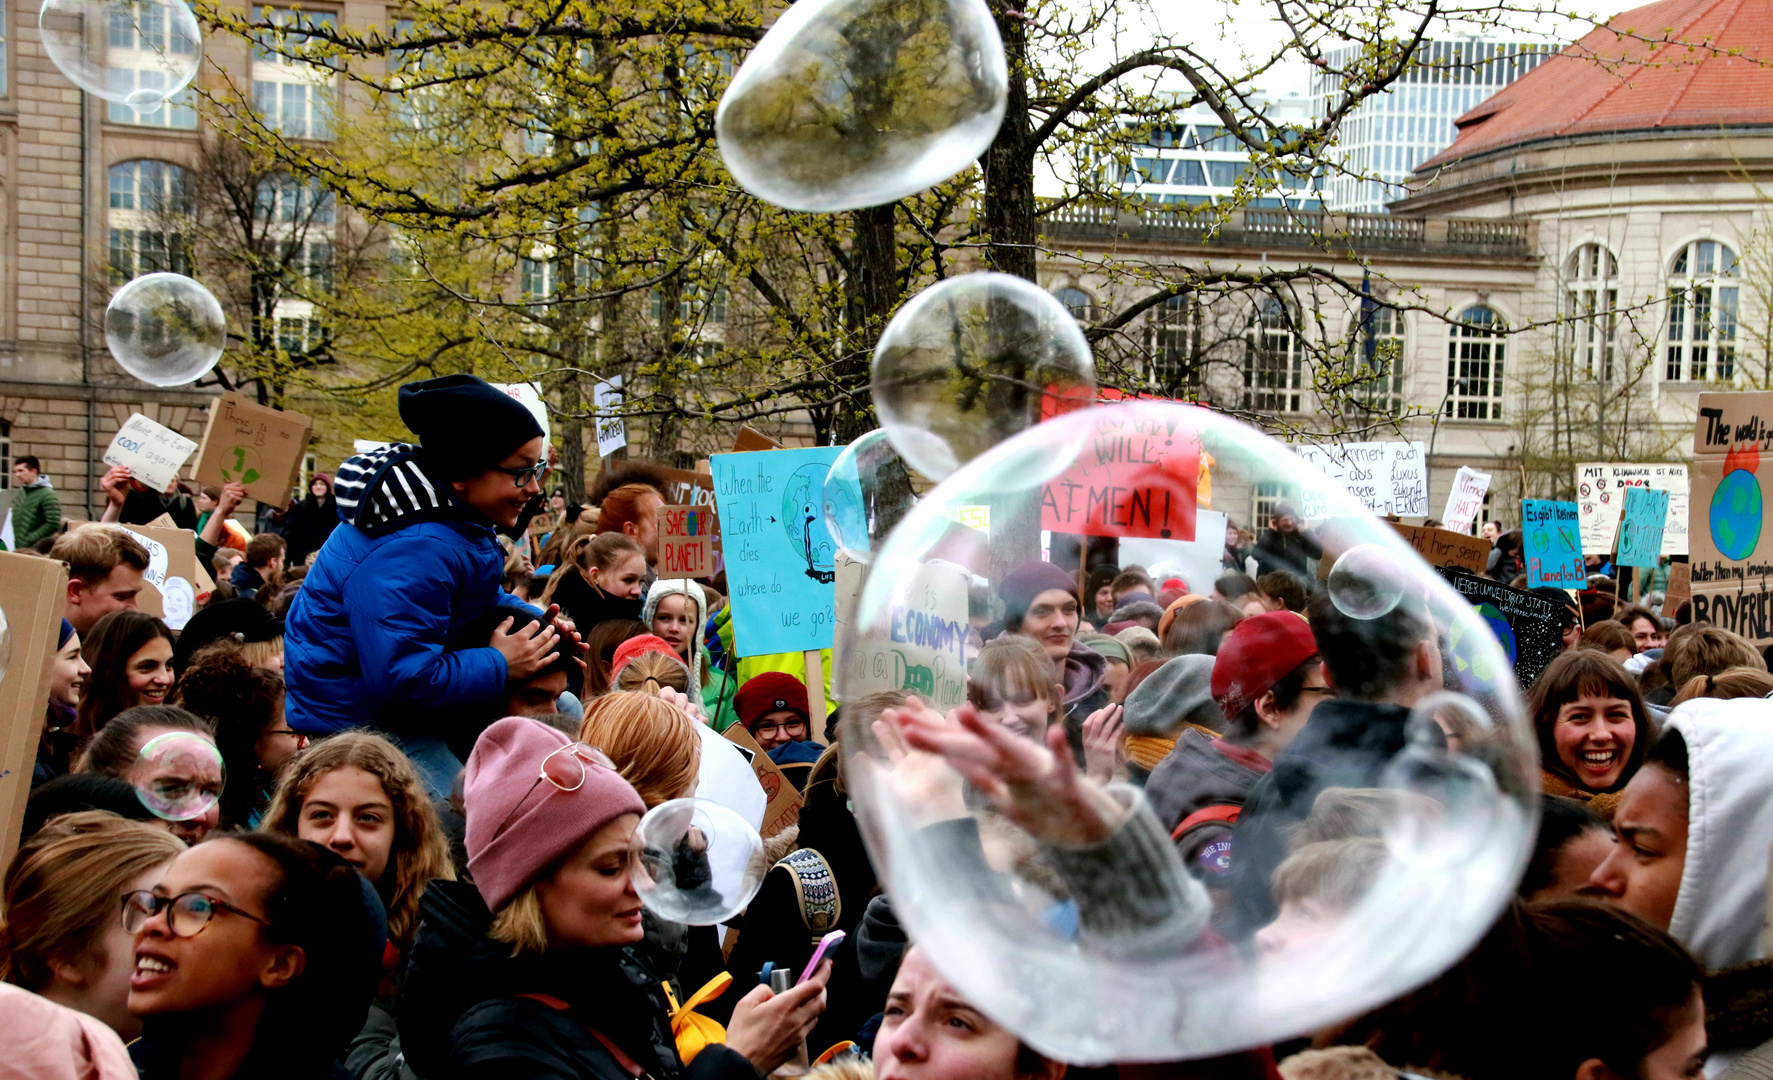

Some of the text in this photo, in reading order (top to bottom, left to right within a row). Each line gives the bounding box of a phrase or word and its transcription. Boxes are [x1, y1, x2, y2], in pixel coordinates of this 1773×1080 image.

[126, 420, 192, 454] Make the Earth
[254, 431, 266, 446] B
[1700, 407, 1730, 446] The
[1735, 415, 1758, 442] world
[1759, 420, 1765, 440] is
[117, 437, 177, 469] cool again
[1094, 436, 1154, 464] WILL
[1395, 445, 1419, 460] euch
[719, 461, 773, 496] When the
[1390, 460, 1419, 481] Luxus
[1584, 467, 1603, 477] MIT
[727, 501, 764, 536] Earth
[1454, 499, 1480, 518] HALT
[1526, 503, 1579, 527] Es gibt keinen
[665, 509, 687, 536] SAVE
[739, 539, 760, 562] dies
[1430, 531, 1455, 556] hier
[1456, 545, 1482, 562] sein
[1573, 558, 1585, 581] B
[1714, 561, 1731, 580] than
[1731, 566, 1744, 596] my
[737, 572, 782, 597] where do
[924, 583, 937, 610] is
[781, 604, 833, 638] we go?
[890, 604, 970, 667] ECONOMY
[873, 652, 889, 680] a
[932, 654, 965, 706] Planet
[1201, 844, 1217, 858] THE
